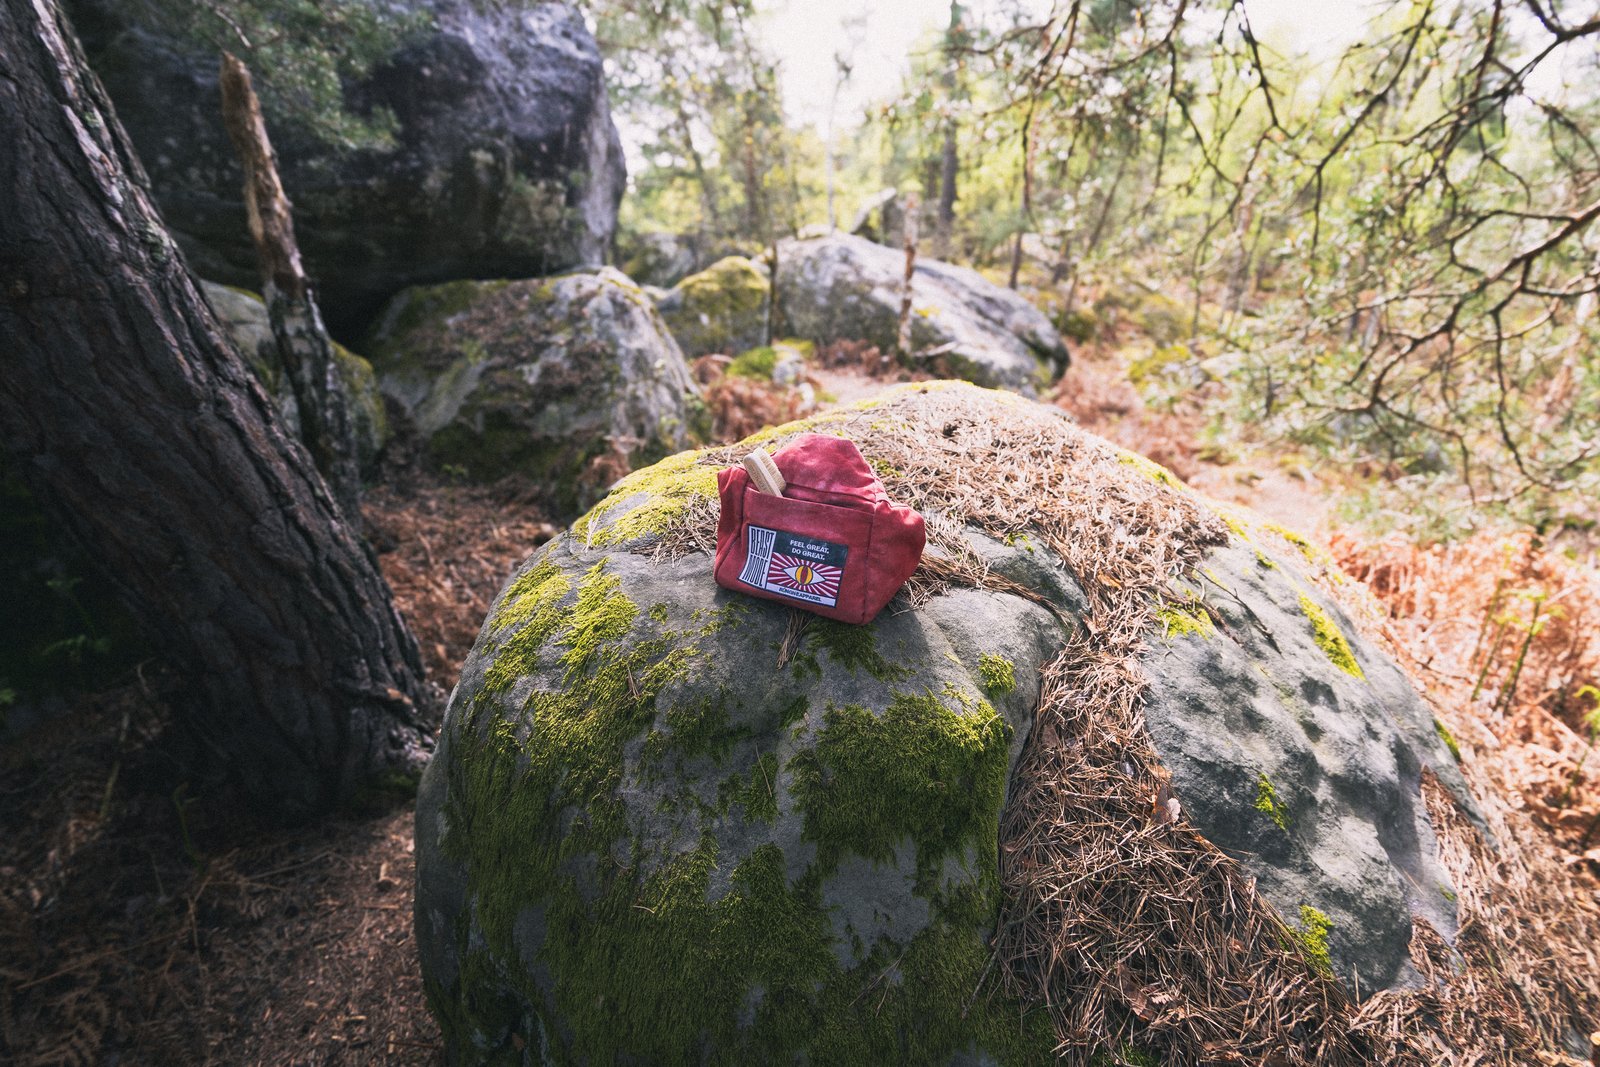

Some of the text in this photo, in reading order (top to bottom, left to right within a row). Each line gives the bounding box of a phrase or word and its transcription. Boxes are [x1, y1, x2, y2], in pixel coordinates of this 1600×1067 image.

[751, 528, 775, 560] BEAST
[790, 540, 829, 554] FEEL GREAT.
[791, 547, 825, 560] DO GREAT.
[741, 554, 769, 587] MODE
